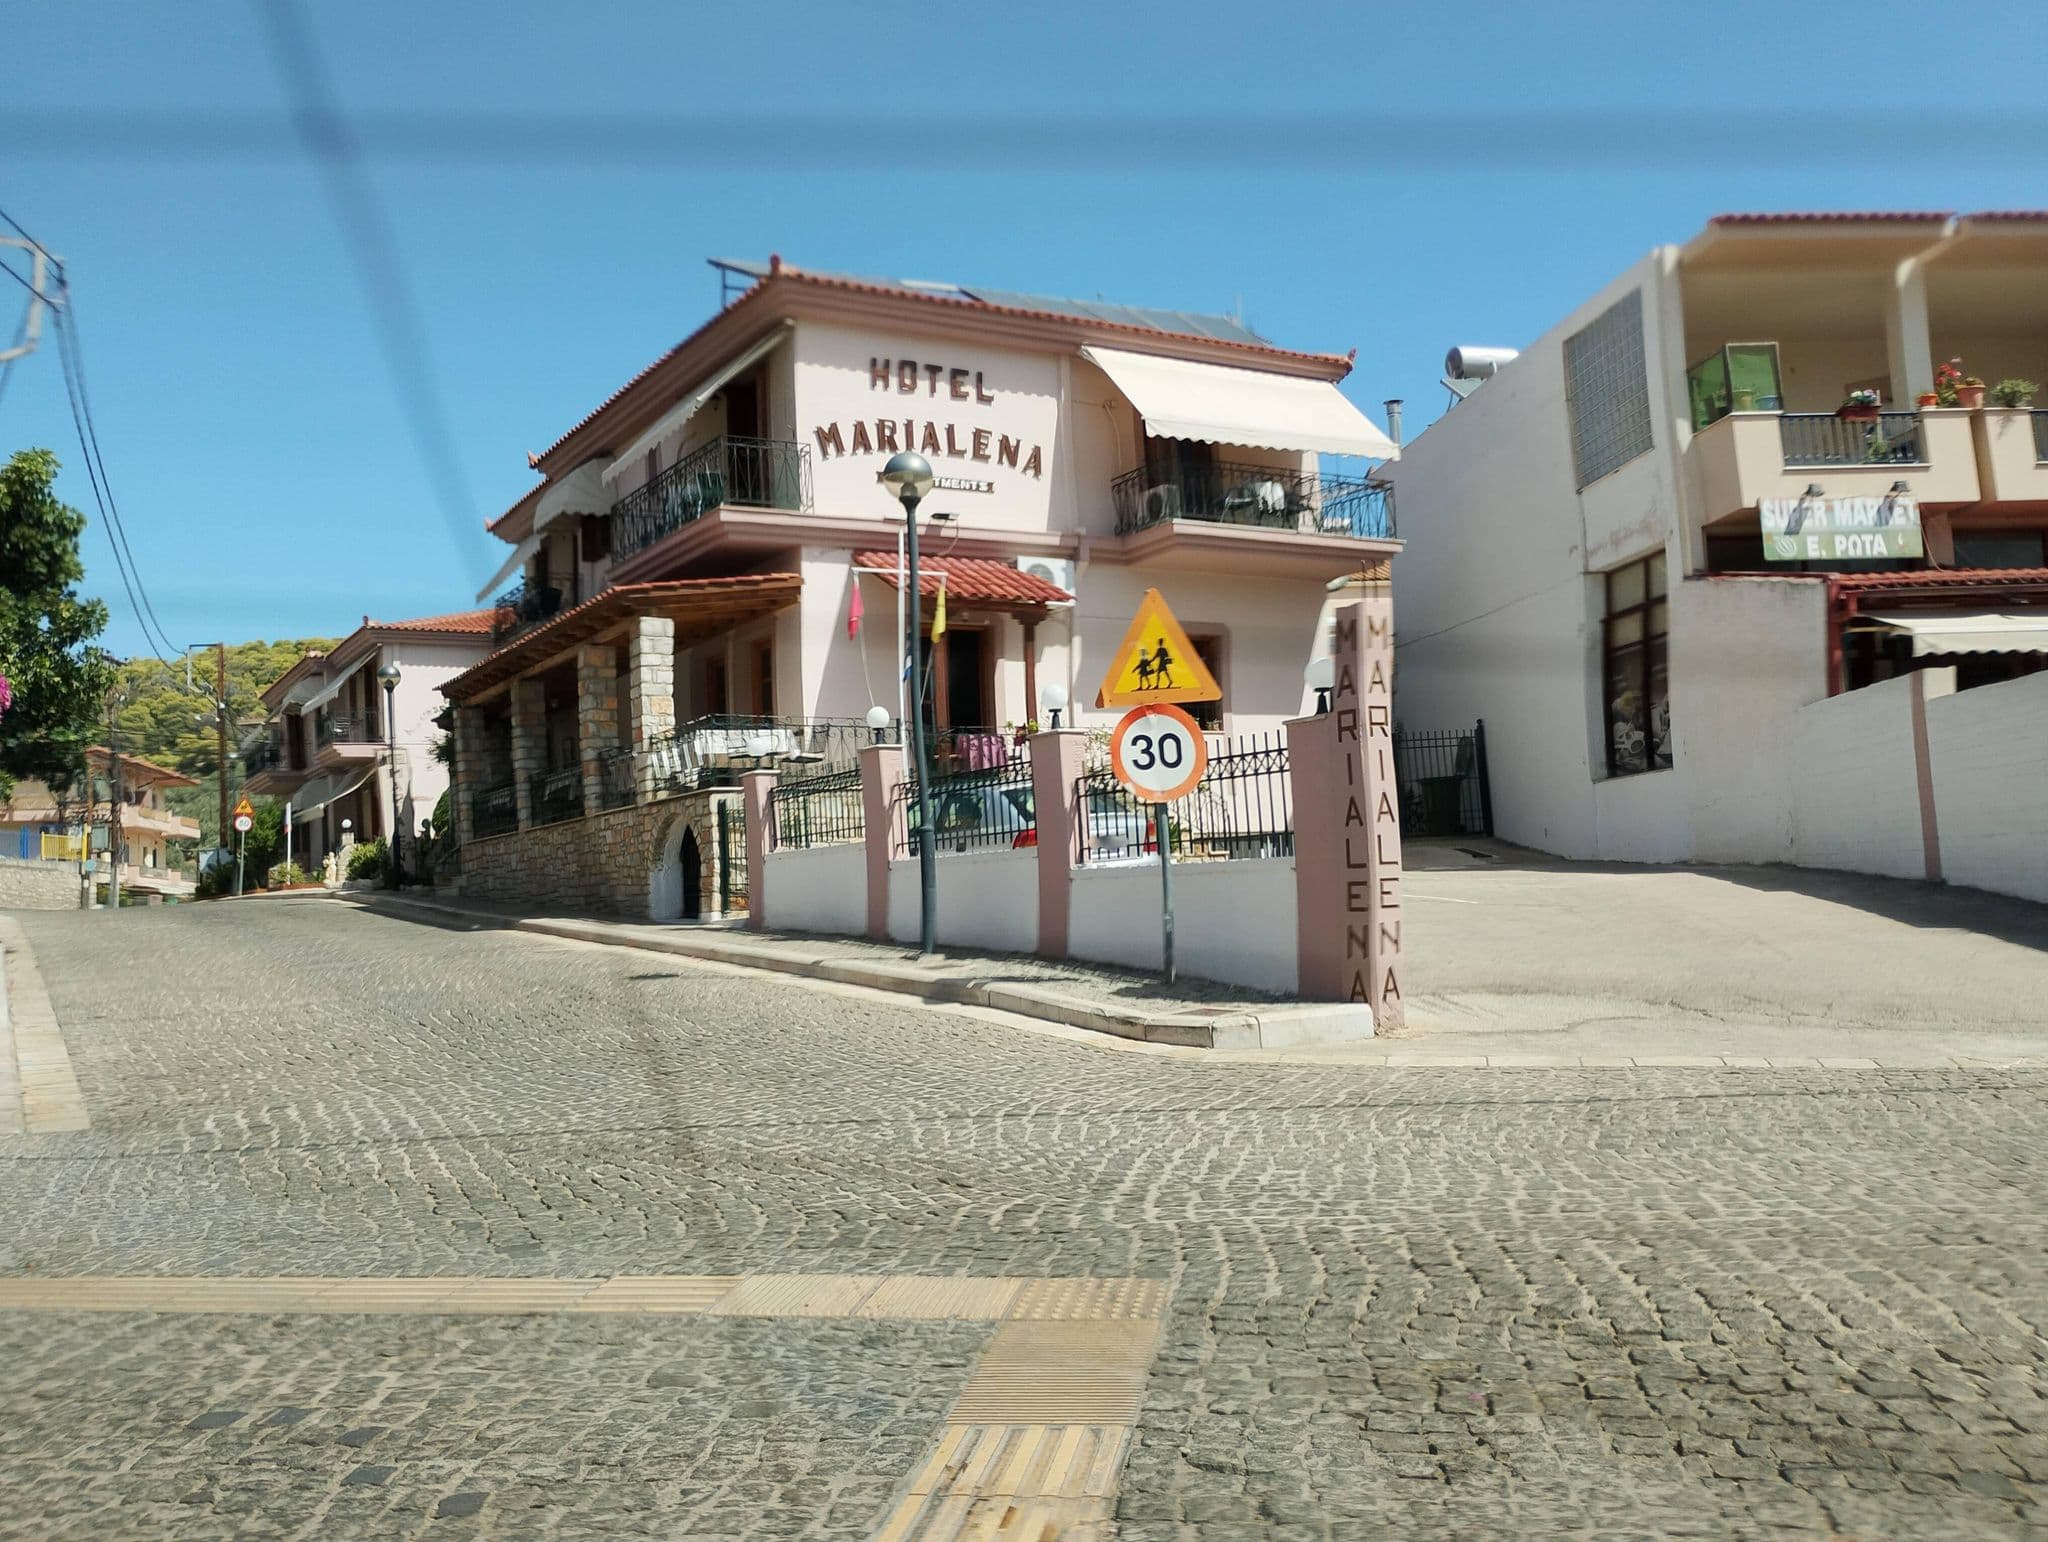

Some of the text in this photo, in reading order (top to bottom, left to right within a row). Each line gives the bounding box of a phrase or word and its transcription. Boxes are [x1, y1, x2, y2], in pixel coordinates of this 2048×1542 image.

[870, 357, 994, 405] HOTEL
[814, 418, 1042, 480] MARIALENA
[1131, 733, 1182, 770] 30
[1335, 616, 1370, 1003] MARIALENA
[1366, 614, 1400, 1002] MARIALENA
